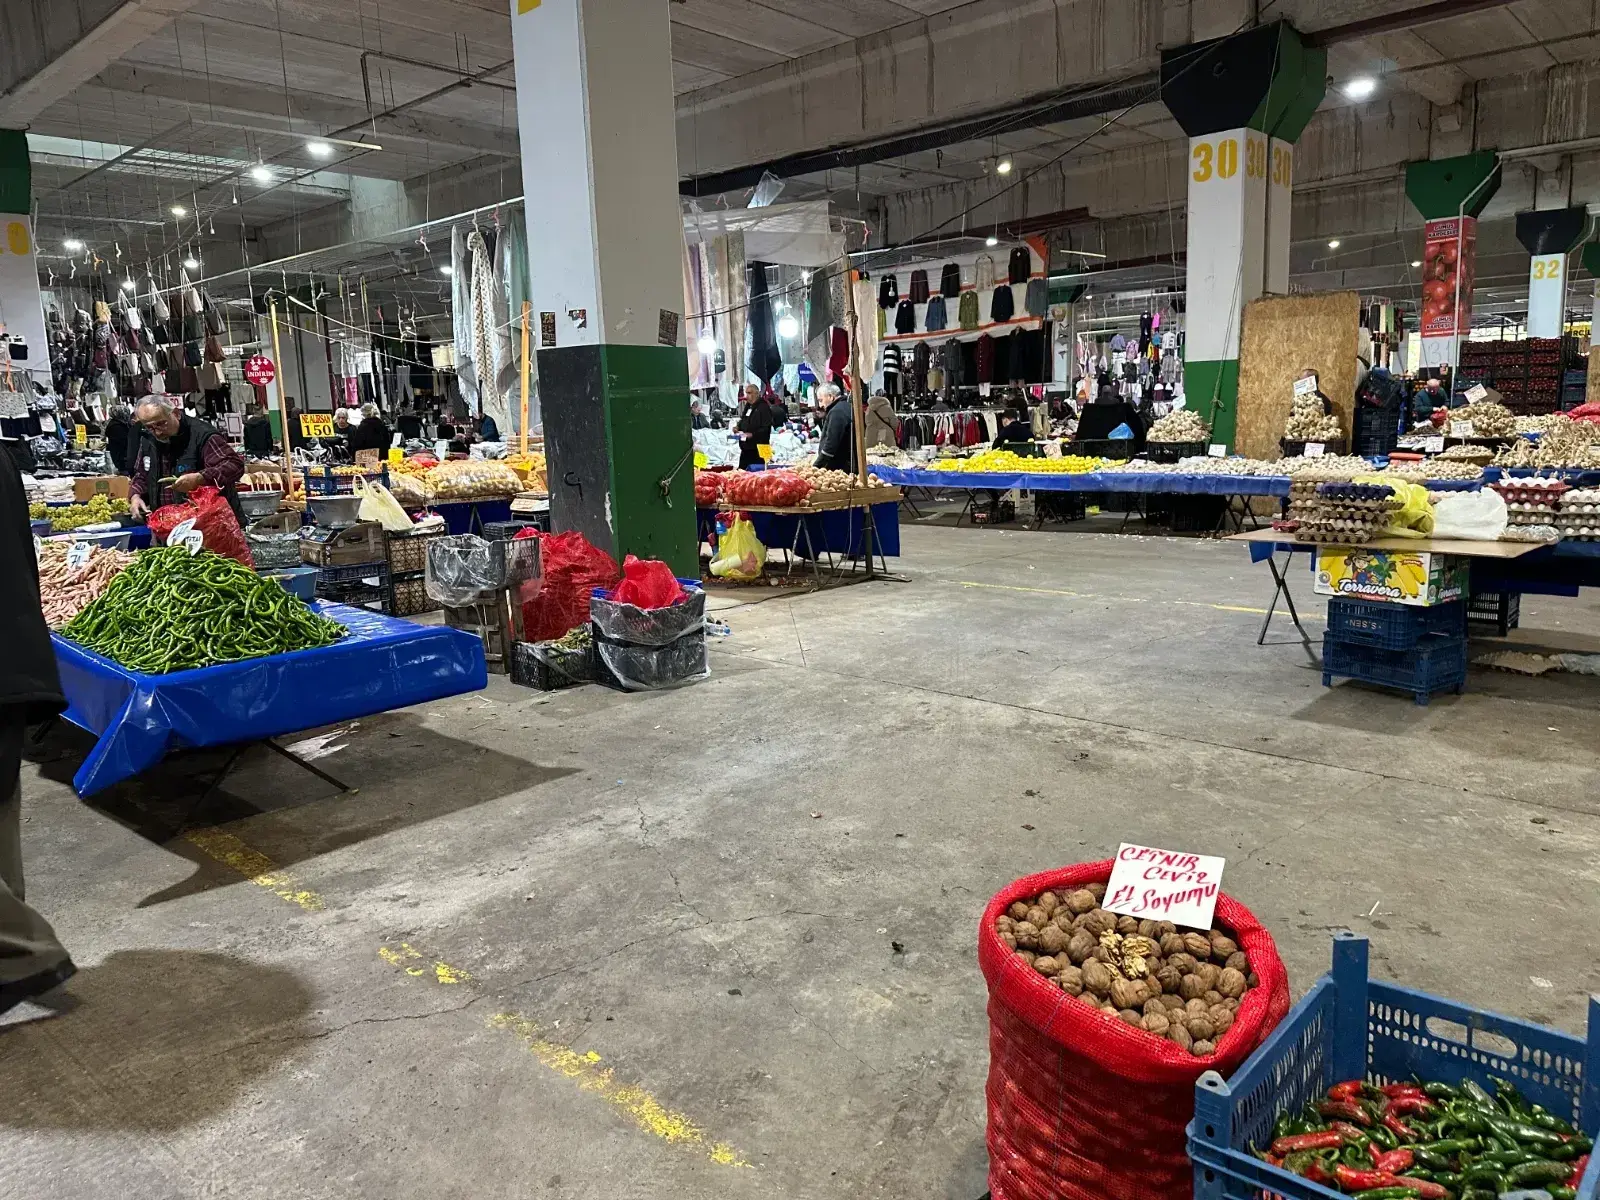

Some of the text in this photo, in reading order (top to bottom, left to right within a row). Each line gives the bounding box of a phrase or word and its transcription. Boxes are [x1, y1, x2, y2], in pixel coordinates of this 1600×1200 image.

[1192, 138, 1238, 183] 30
[1246, 136, 1265, 178] 30
[1272, 147, 1291, 188] 30
[1533, 259, 1560, 280] 32
[304, 424, 332, 436] 150
[1338, 578, 1402, 598] Terravera
